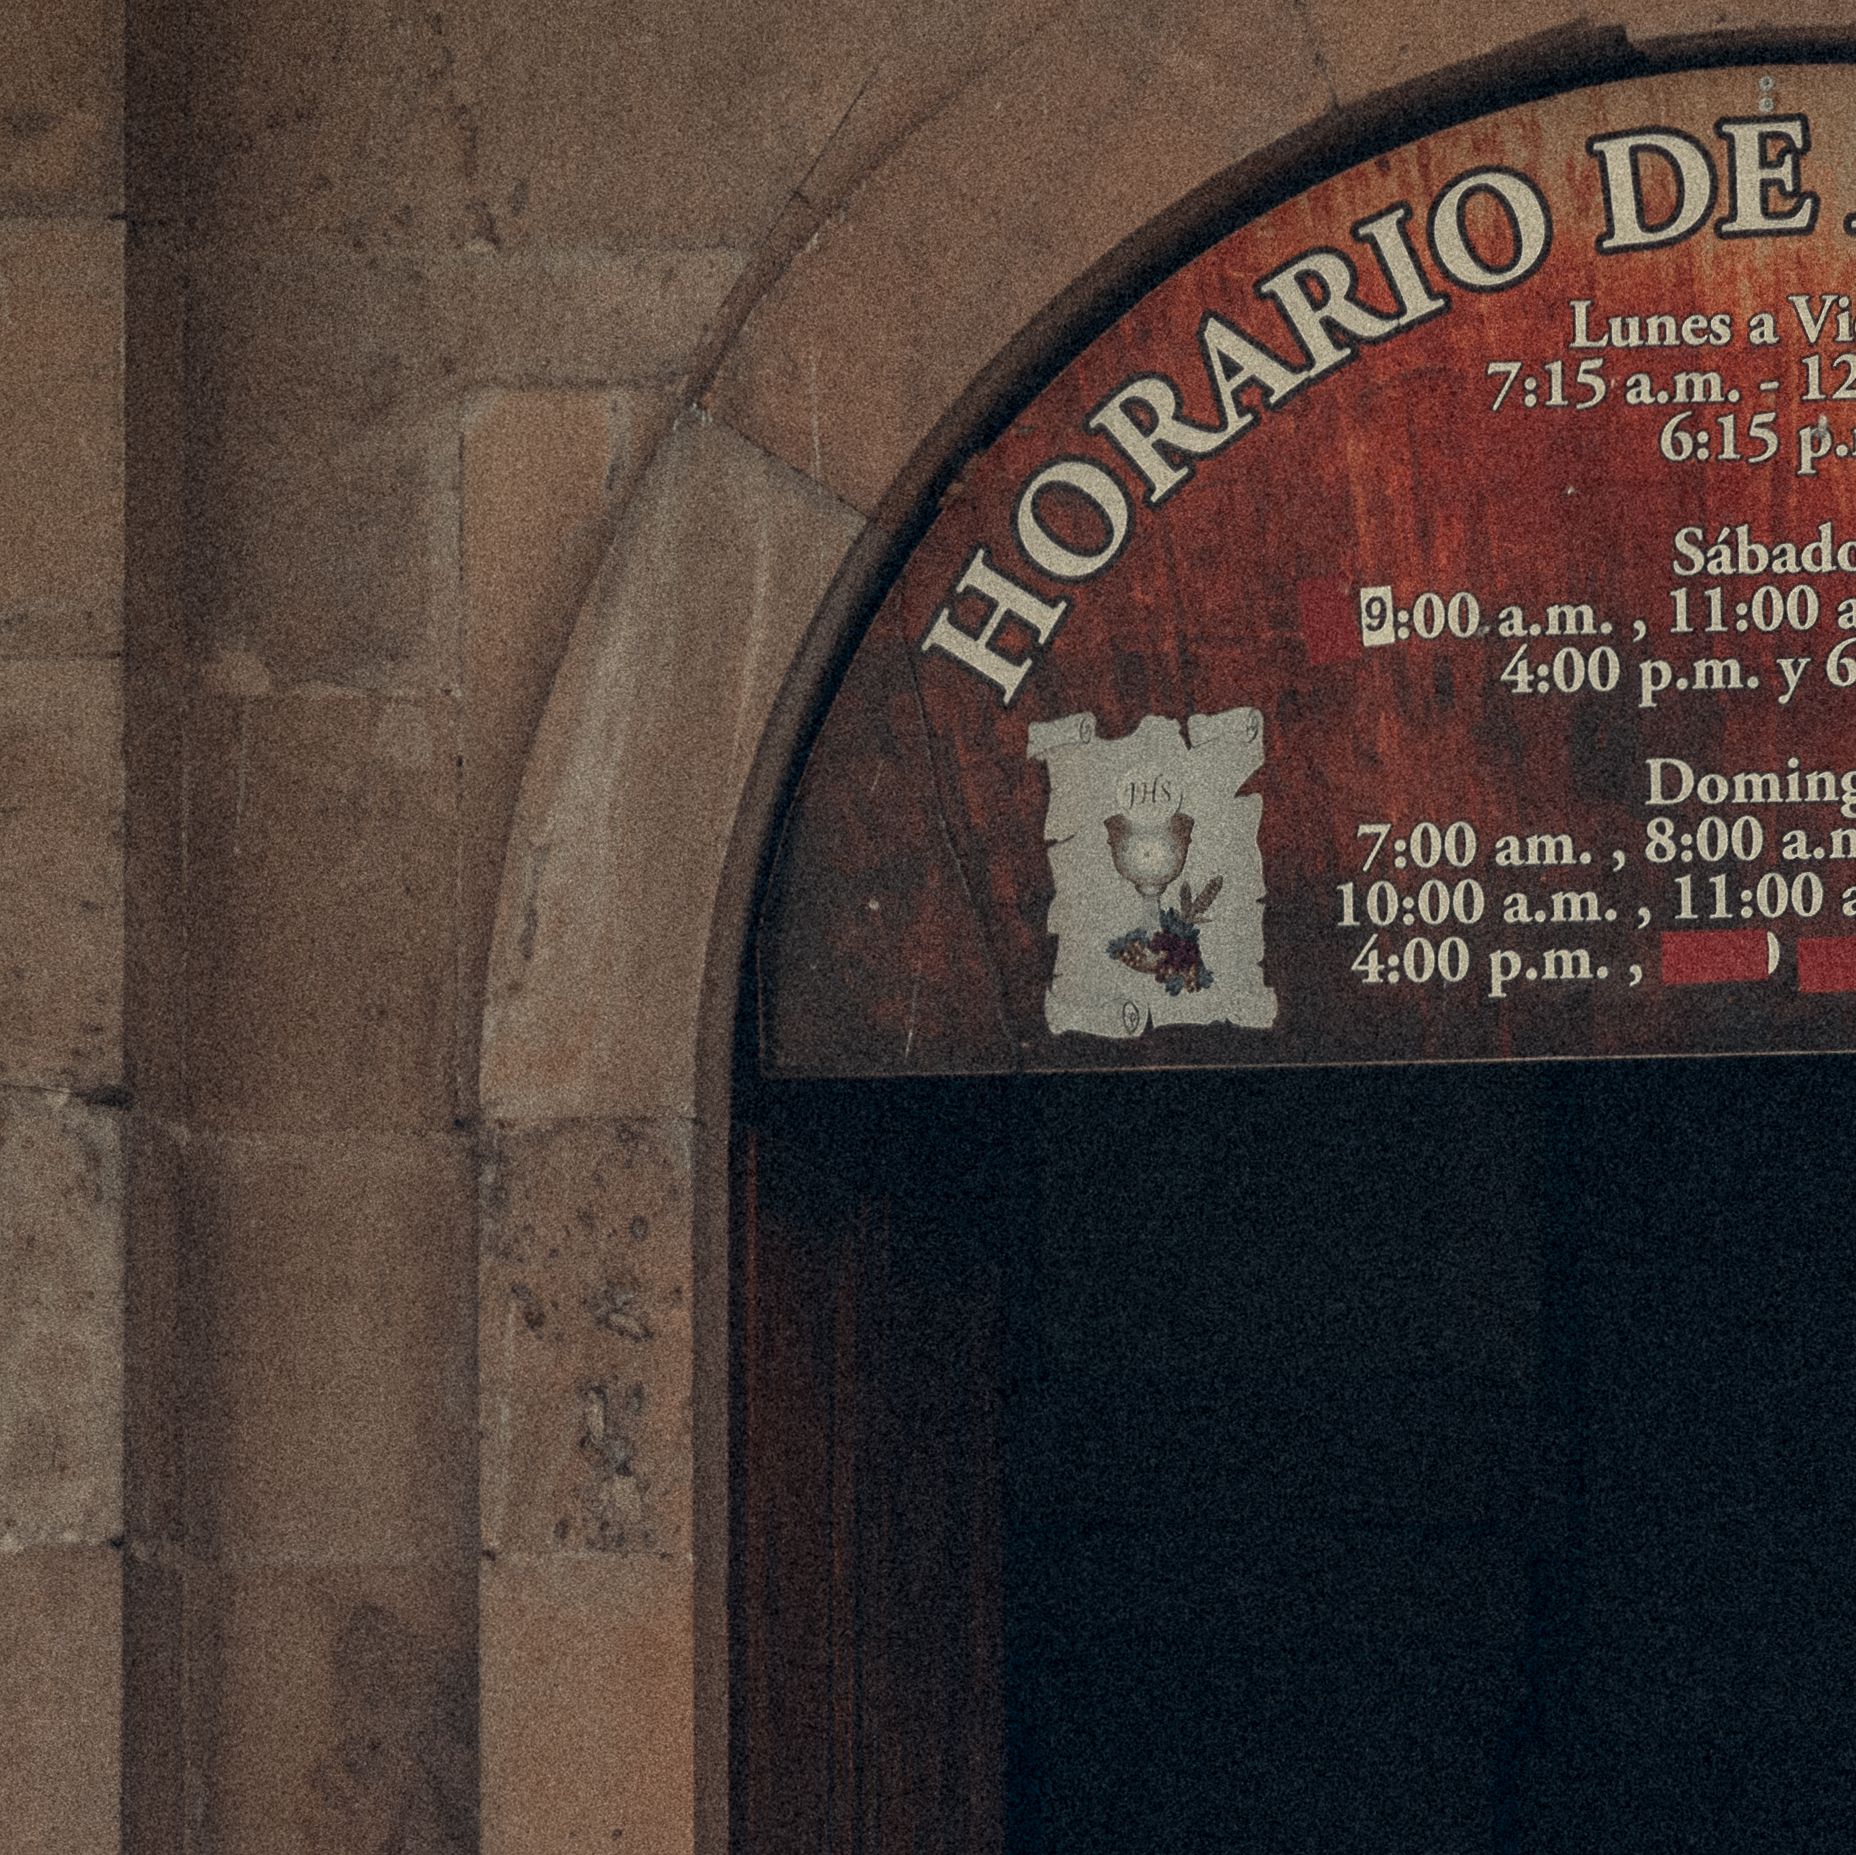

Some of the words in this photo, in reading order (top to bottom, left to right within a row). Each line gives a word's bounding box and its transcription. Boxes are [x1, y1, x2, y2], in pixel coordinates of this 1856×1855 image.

[1572, 301, 1730, 347] Lunes
[1750, 314, 1777, 344] a
[922, 173, 1546, 703] HORARIO
[1594, 120, 1811, 247] DE
[1488, 359, 1605, 409] 7:15
[1626, 373, 1739, 404] a.m.
[1661, 413, 1777, 462] 6:15
[1364, 592, 1479, 640] 9:00
[1499, 605, 1612, 637] a.m.
[1672, 585, 1818, 632] 11:00
[1501, 645, 1620, 693] 4:00
[1640, 659, 1758, 707] p.m.
[1778, 658, 1809, 704] y
[1358, 822, 1476, 871] 7:00
[1496, 835, 1591, 866] am.
[1645, 816, 1763, 863] 8:00
[1339, 879, 1484, 926] 10:00
[1504, 892, 1616, 923] a.m.
[1676, 872, 1823, 919] 11:00
[1352, 934, 1469, 983] 4:00
[1490, 949, 1608, 997] p.m.
